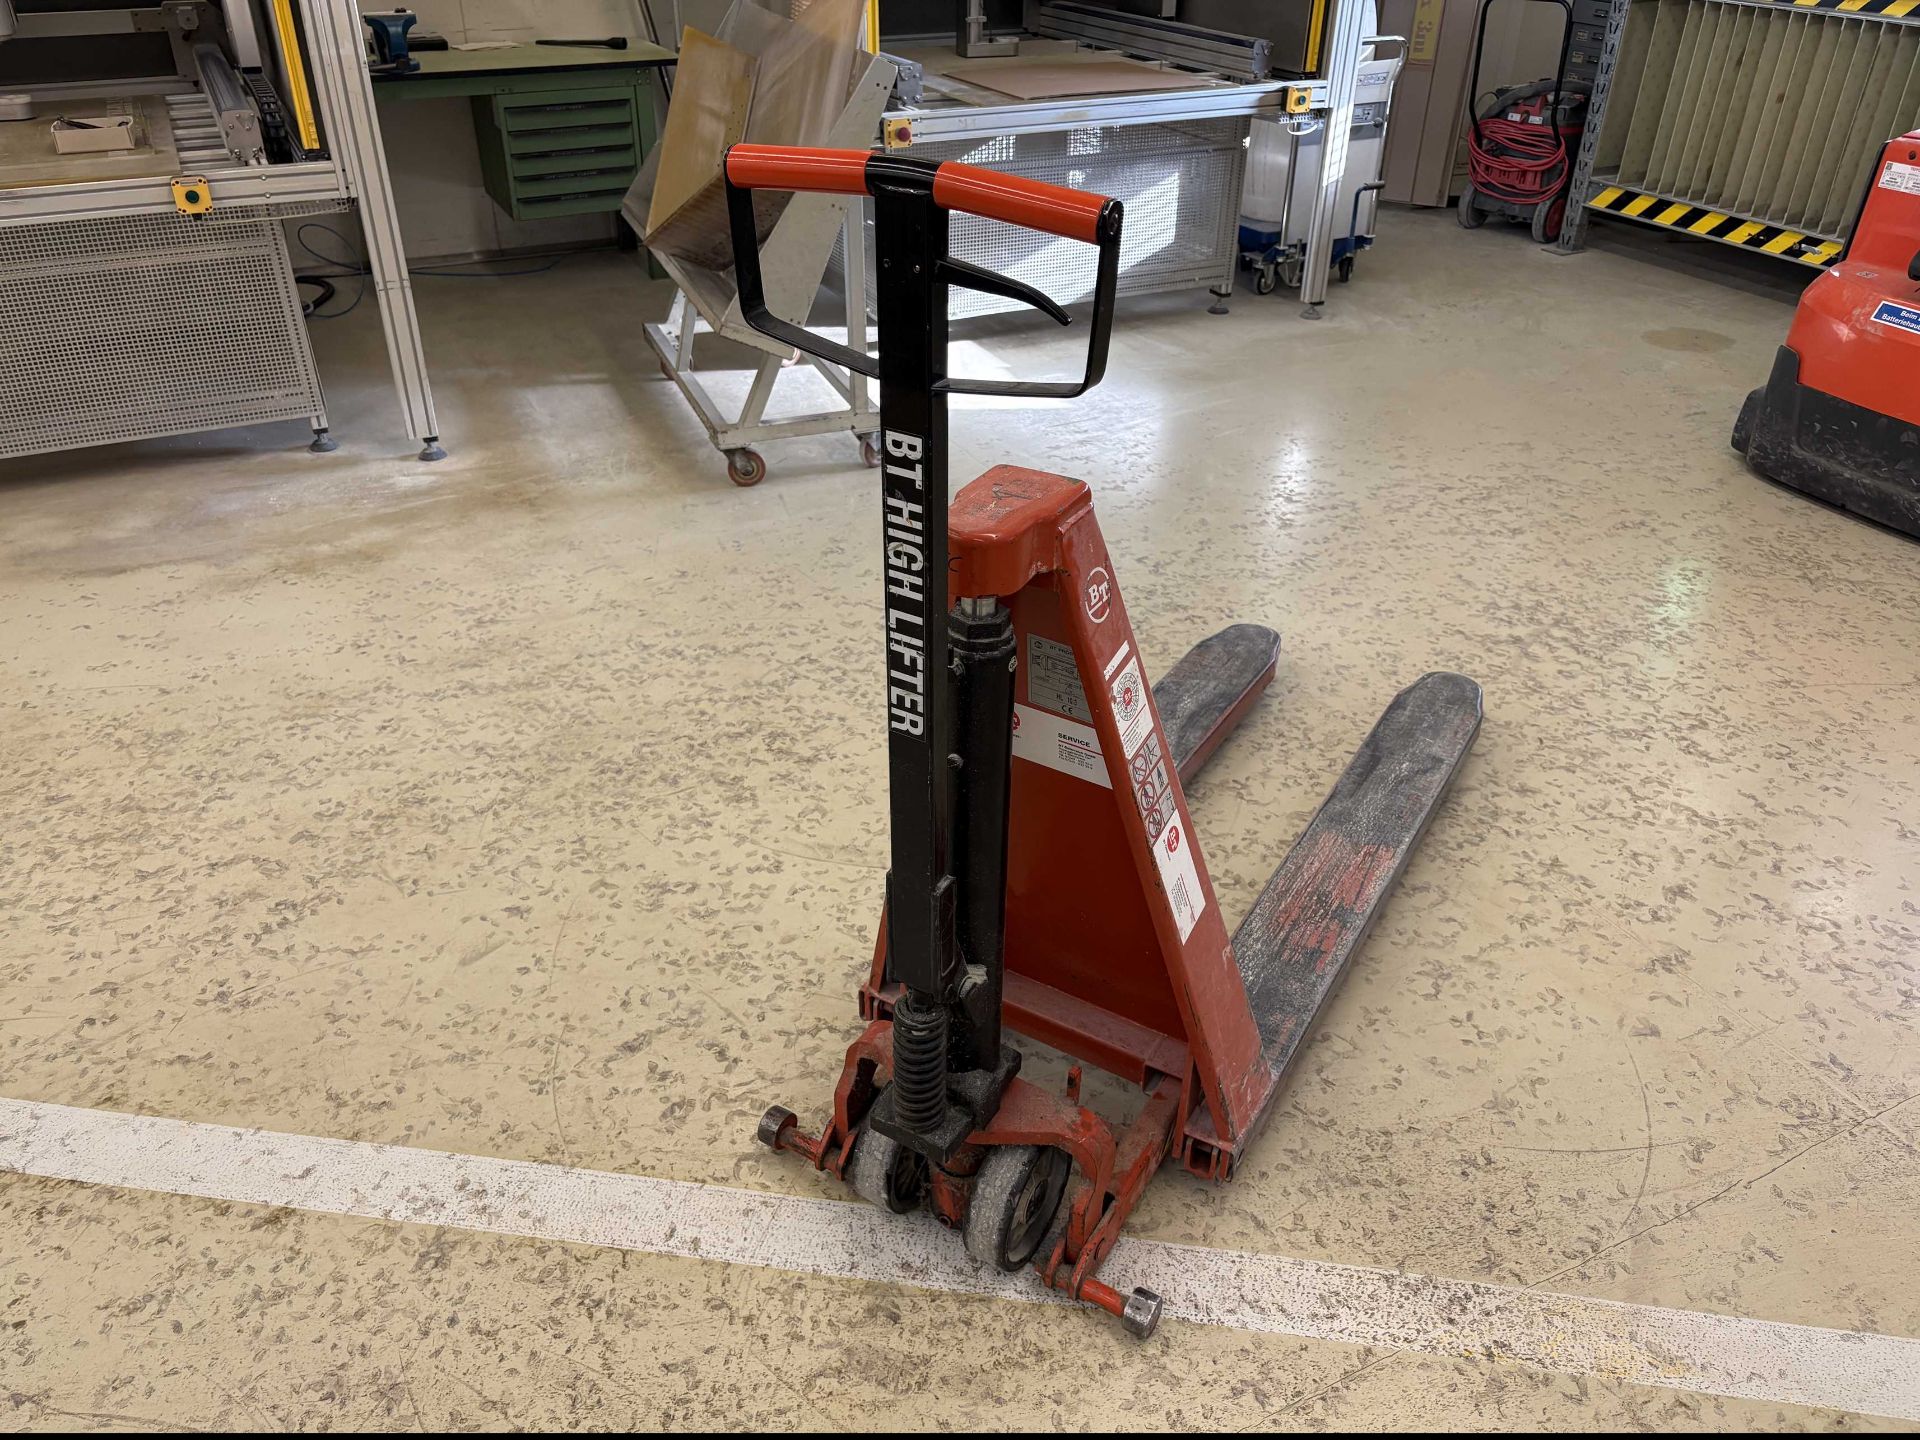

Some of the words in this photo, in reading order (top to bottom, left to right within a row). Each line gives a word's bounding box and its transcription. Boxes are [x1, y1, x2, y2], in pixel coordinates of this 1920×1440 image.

[1900, 310, 1918, 320] Beim
[886, 430, 923, 490] BT
[886, 496, 924, 602] HIGH
[1088, 581, 1111, 607] BT
[889, 607, 925, 736] LIFTER
[1057, 732, 1091, 748] SERVICE
[1169, 827, 1178, 850] BT
